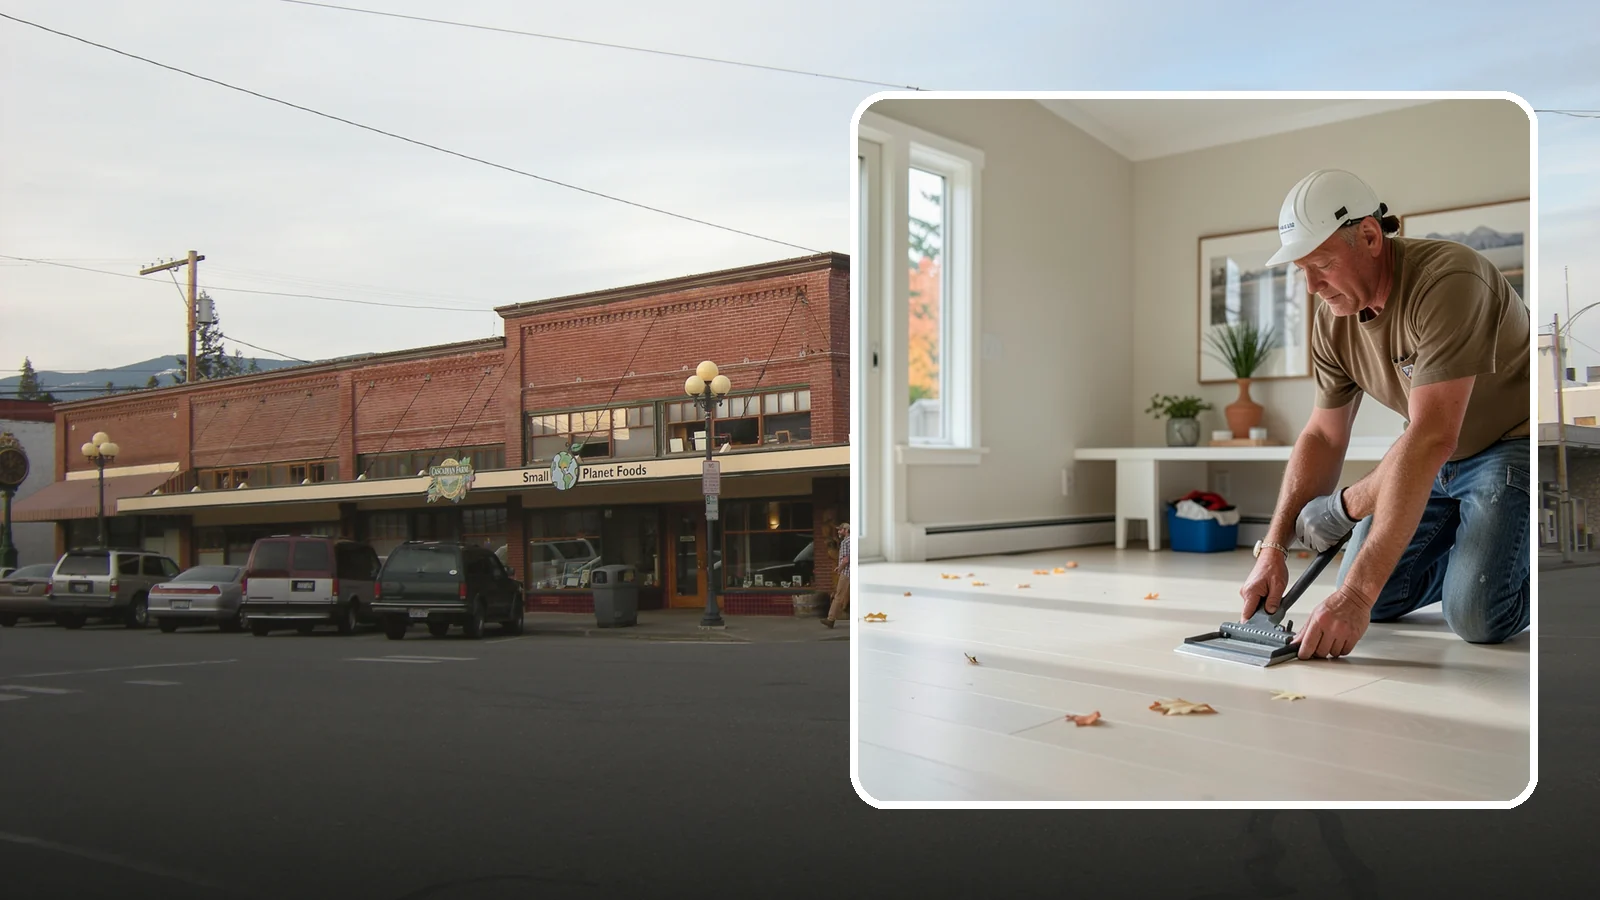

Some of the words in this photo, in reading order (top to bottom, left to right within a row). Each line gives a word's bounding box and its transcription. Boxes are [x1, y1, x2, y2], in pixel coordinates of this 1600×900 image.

[523, 471, 549, 483] Small
[583, 468, 614, 479] Planet
[617, 464, 647, 477] Foods
